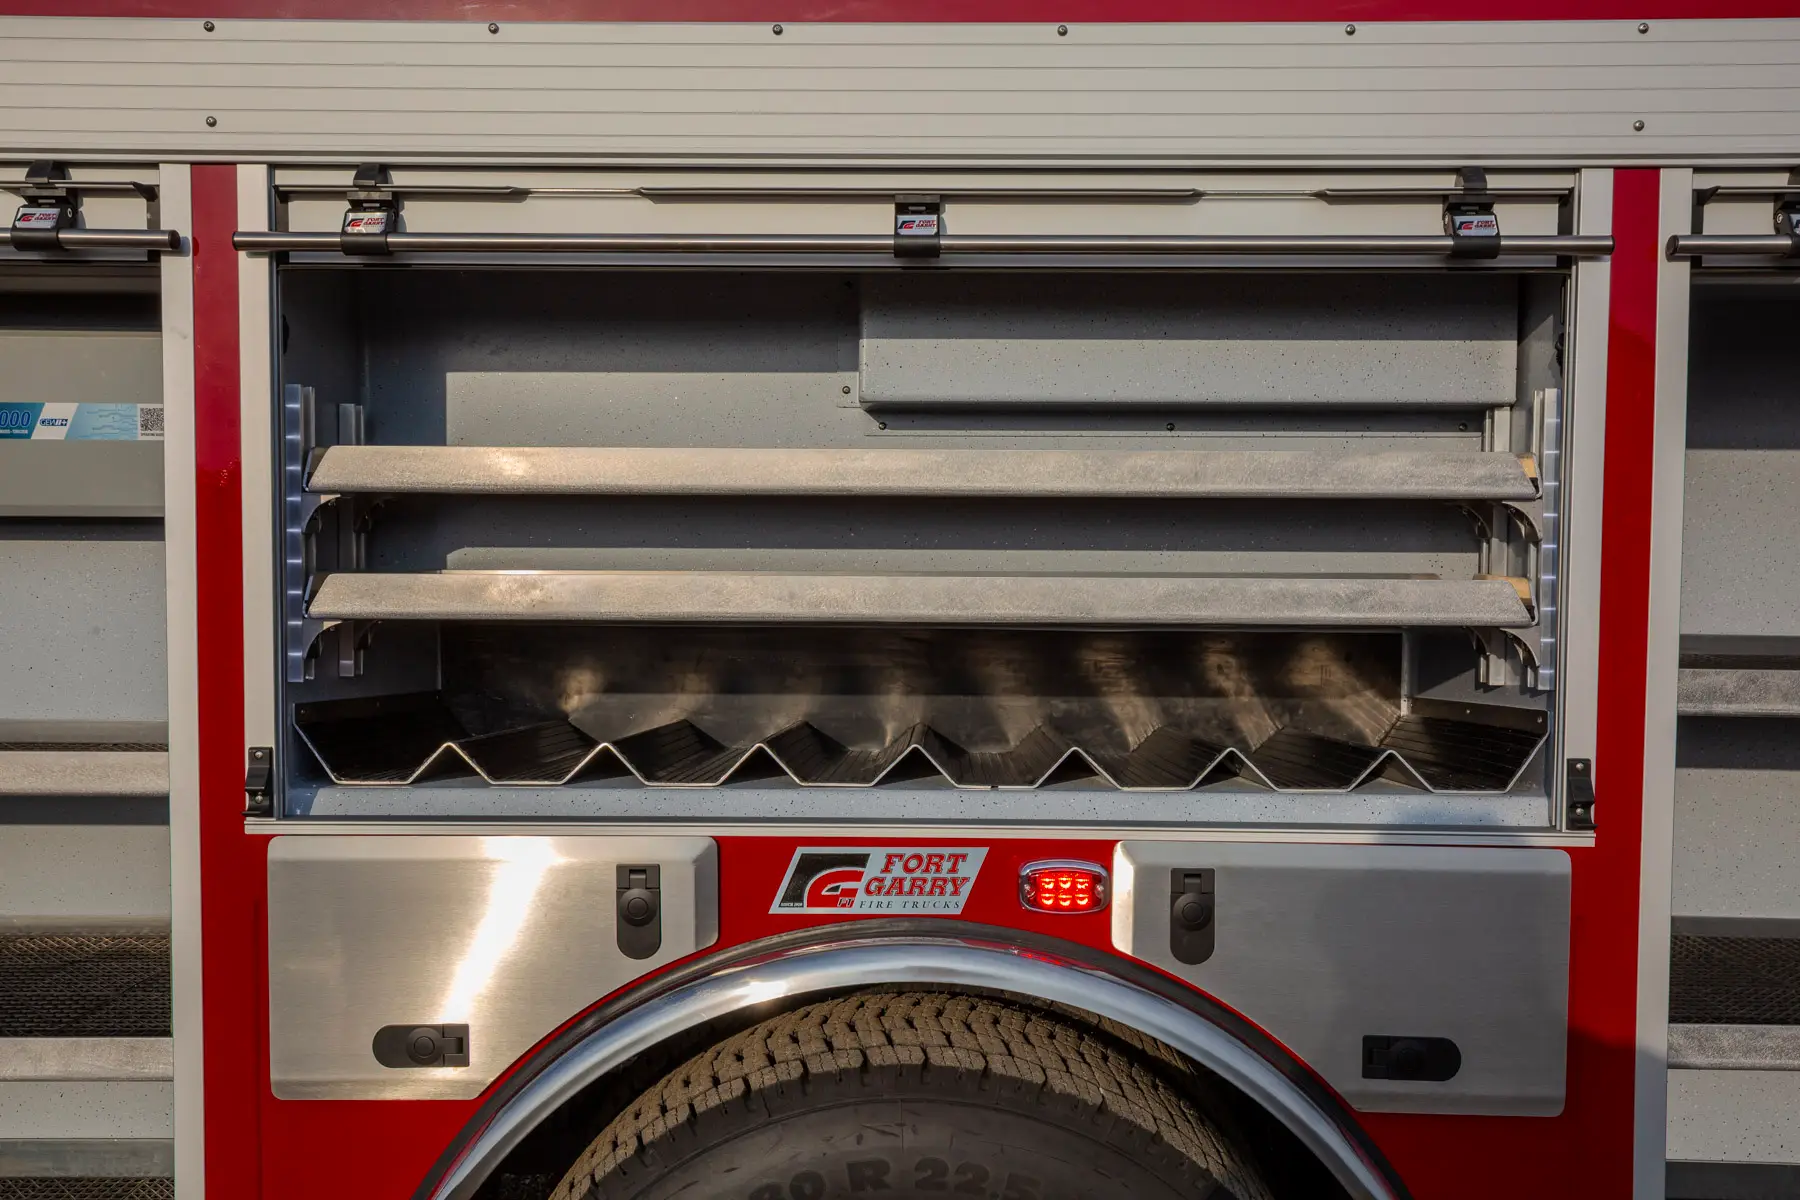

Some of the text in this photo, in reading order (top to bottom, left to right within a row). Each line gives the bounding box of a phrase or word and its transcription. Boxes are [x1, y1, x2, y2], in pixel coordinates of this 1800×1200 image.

[880, 853, 969, 874] FORT
[864, 876, 971, 896] GARRY
[860, 900, 960, 909] FIRE TRUCKS
[846, 1157, 892, 1192] R
